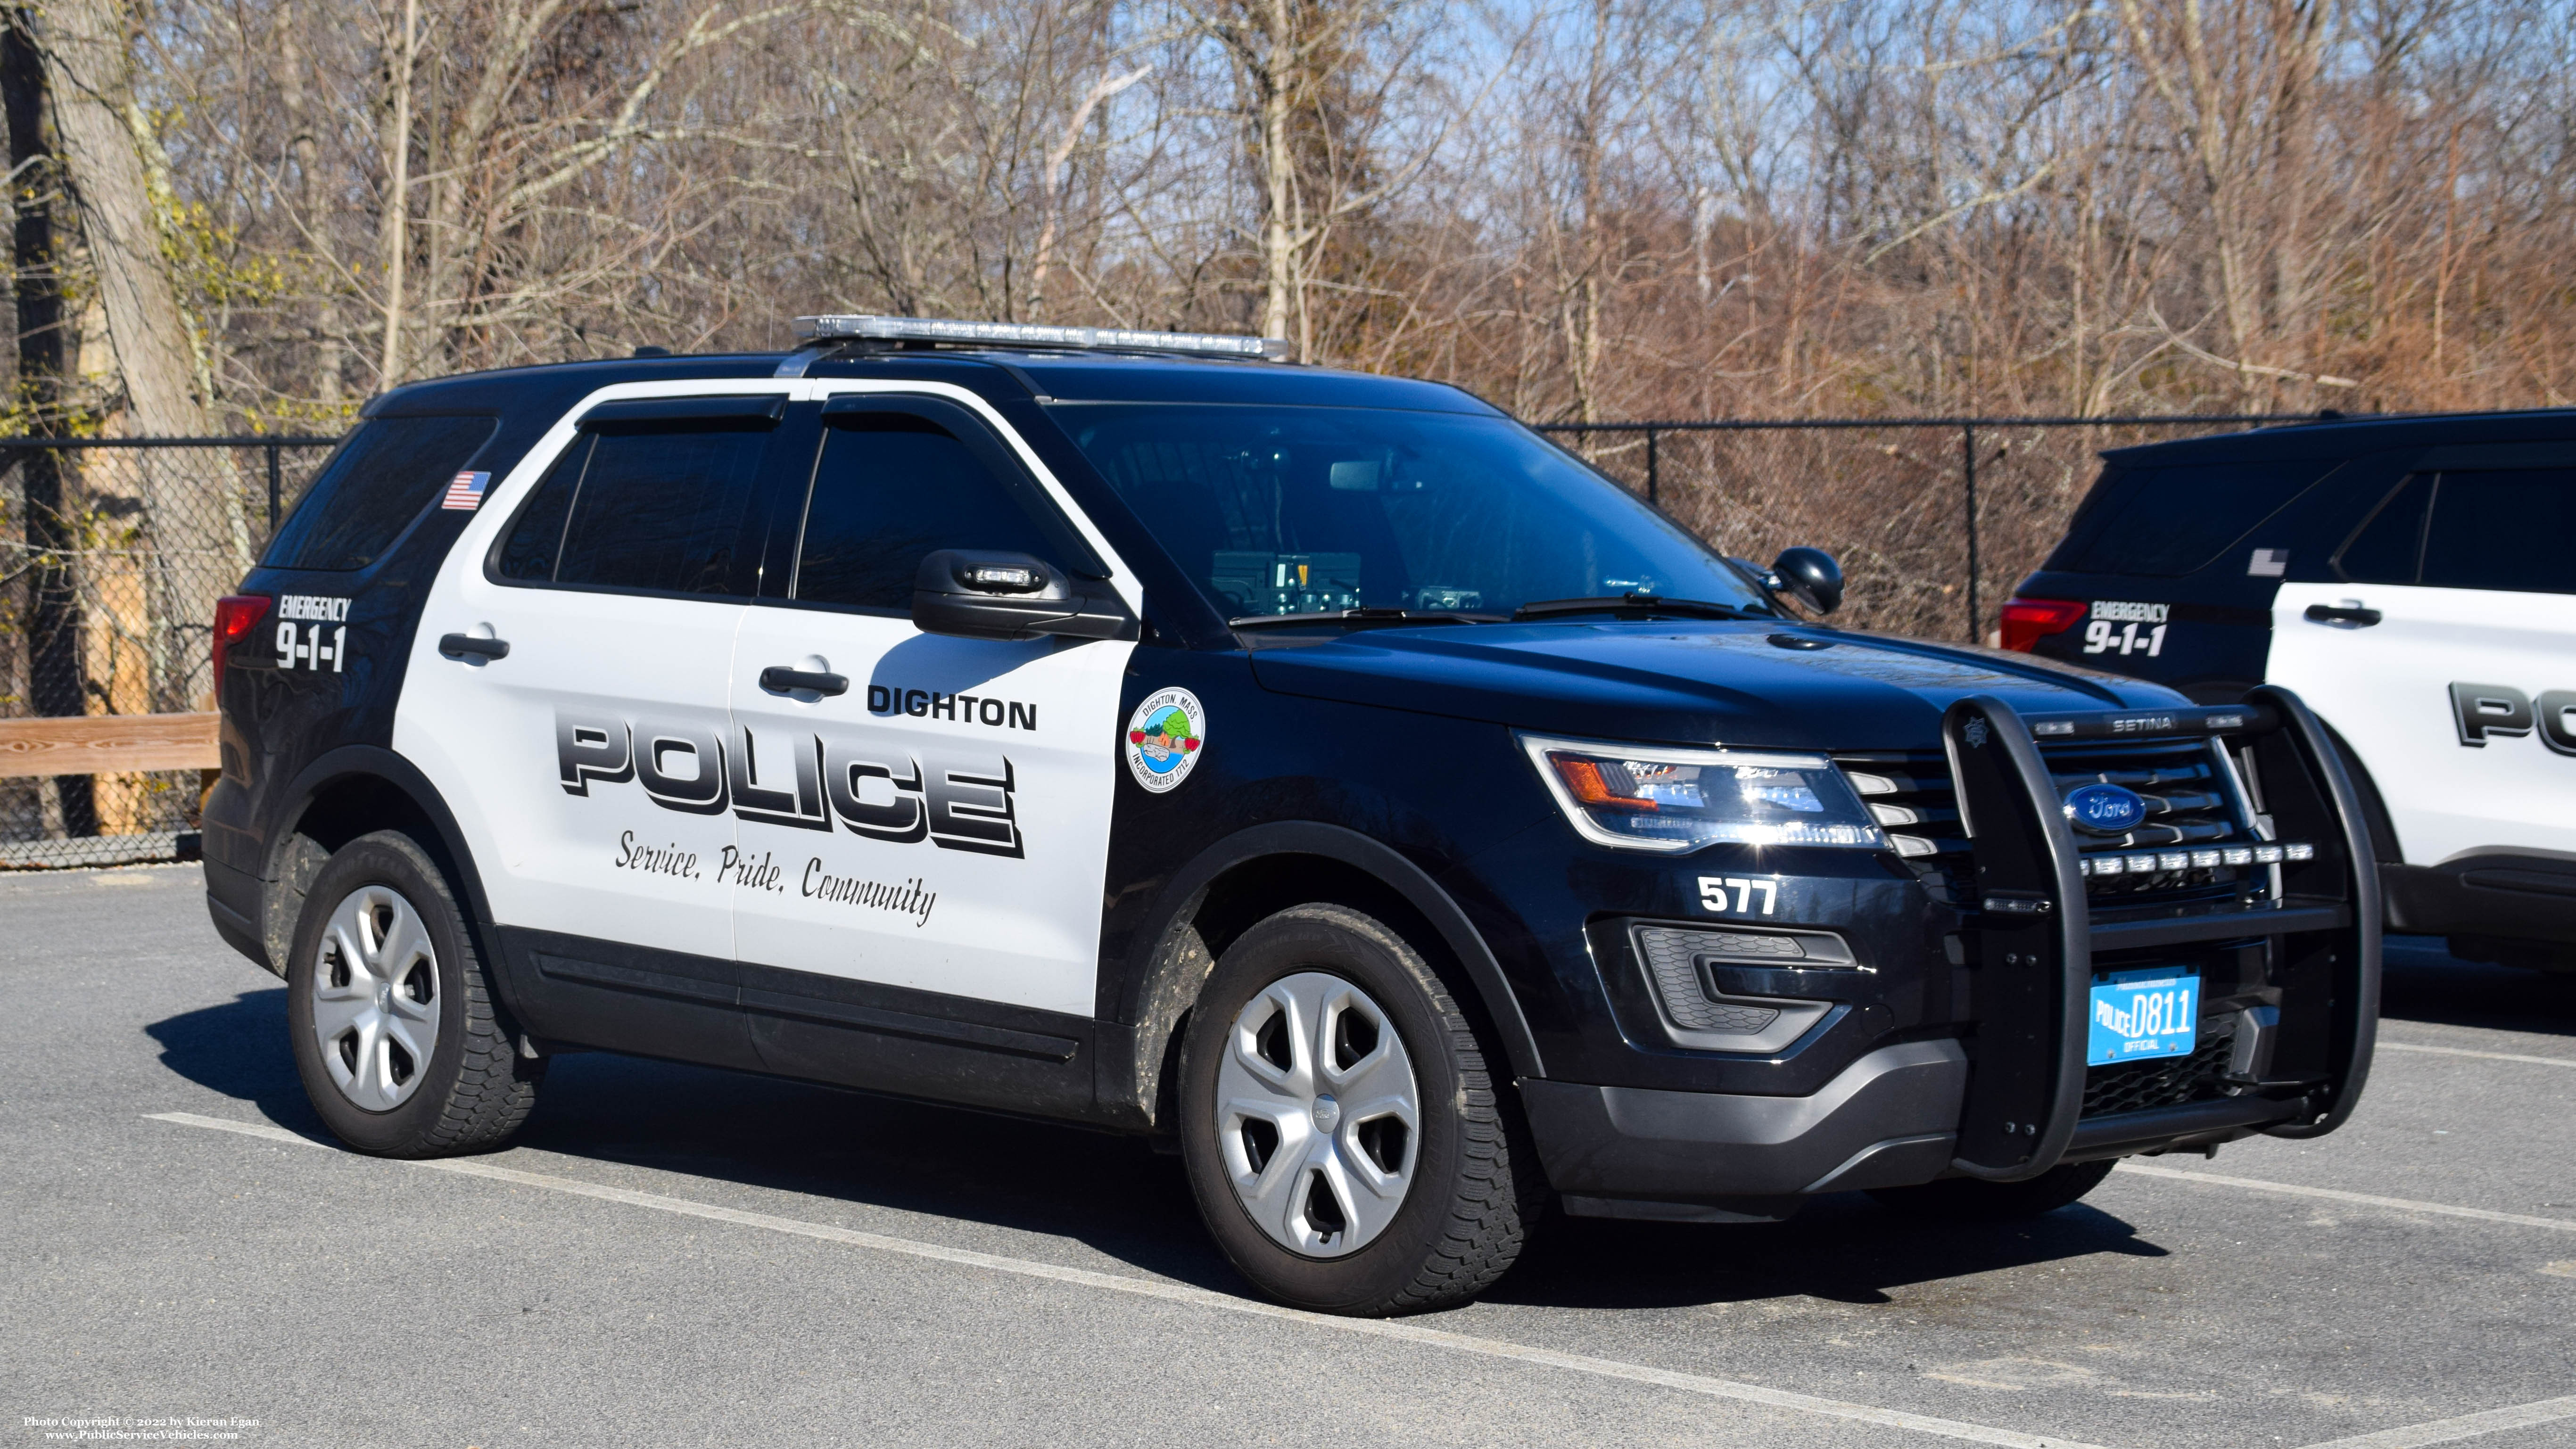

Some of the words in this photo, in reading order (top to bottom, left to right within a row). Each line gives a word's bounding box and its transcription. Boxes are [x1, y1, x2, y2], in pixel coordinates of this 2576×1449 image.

[278, 594, 352, 622] EMERGENCY
[2090, 601, 2170, 623] EMERGENCY
[276, 621, 346, 673] 9-1-1
[2083, 620, 2167, 657] 9-1-1
[867, 684, 1038, 731] DIGHTON
[1143, 694, 1176, 716] DIGHTON,
[1180, 697, 1197, 722] MASS.
[2112, 716, 2172, 733] SETINA
[556, 705, 1026, 860] POLICE
[1133, 753, 1174, 786] INCORPORATED
[1176, 759, 1189, 776] 1712
[2089, 797, 2130, 819] Ford
[616, 830, 701, 883] Service,
[717, 845, 784, 897] Pride,
[801, 856, 938, 928] Community
[1698, 877, 1777, 914] 577
[2096, 999, 2131, 1037] POLICE
[2130, 989, 2190, 1038] D811
[2124, 1039, 2159, 1053] OFFICIAL
